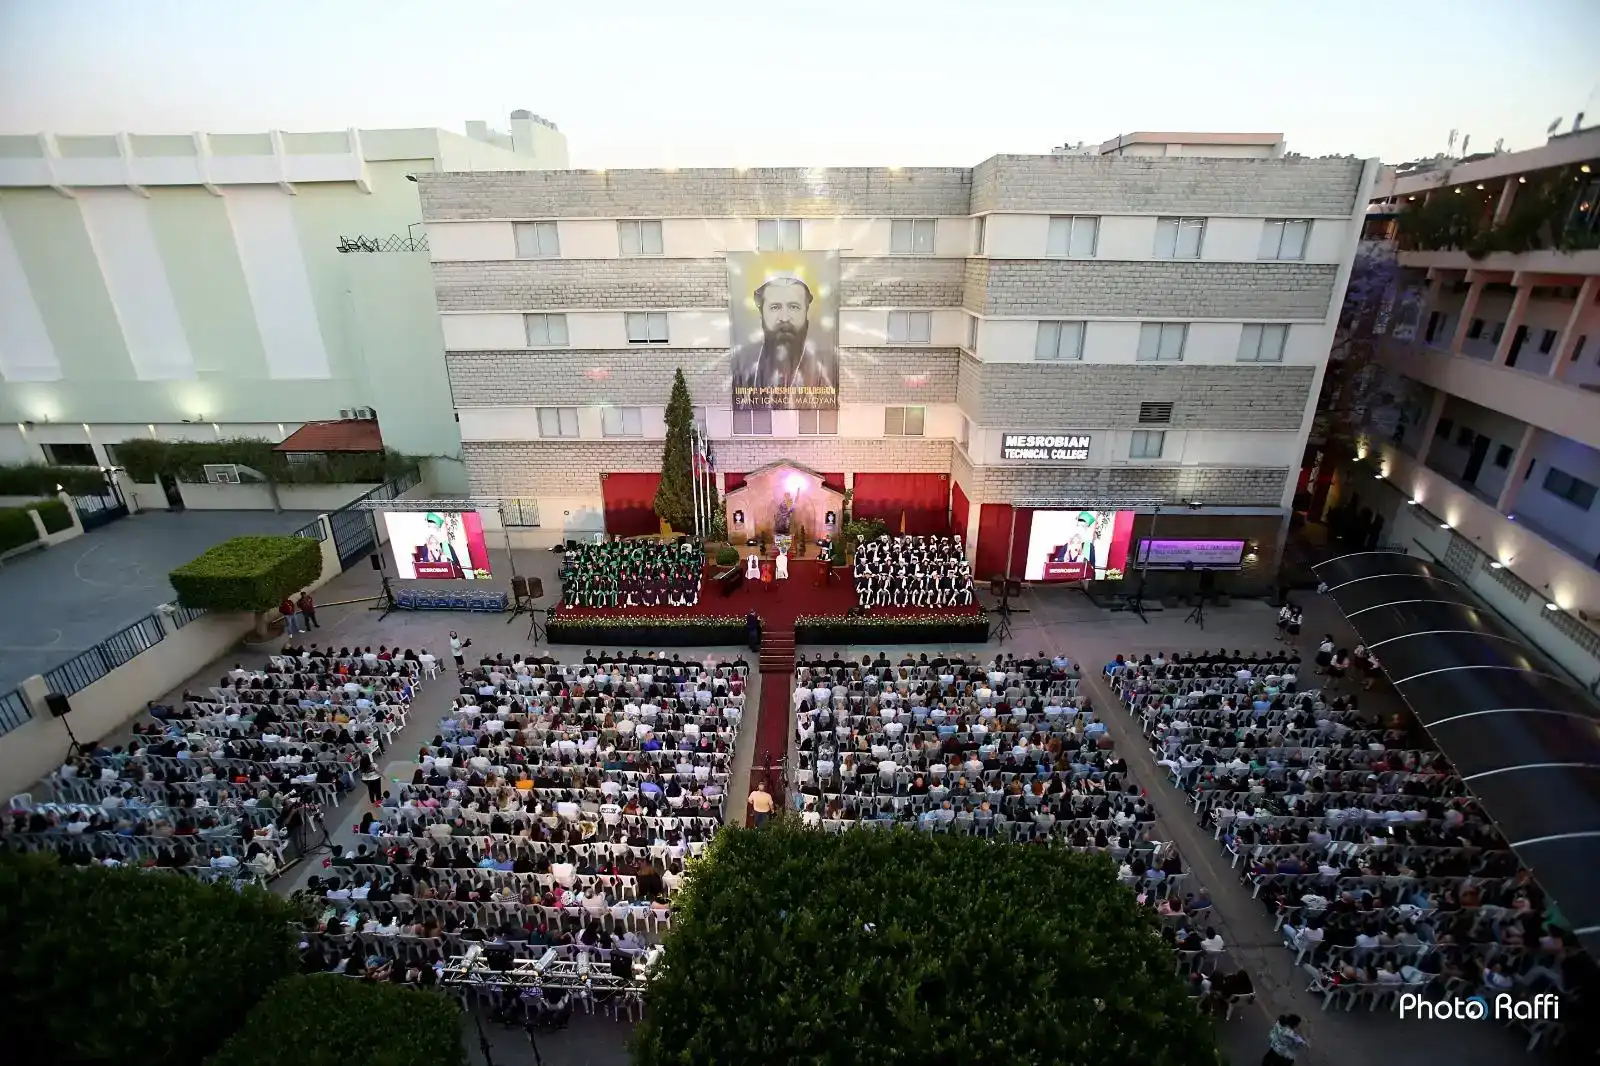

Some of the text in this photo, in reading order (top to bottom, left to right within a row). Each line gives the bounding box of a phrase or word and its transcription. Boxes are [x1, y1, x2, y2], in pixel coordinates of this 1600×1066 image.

[735, 397, 758, 405] SAINT
[761, 397, 791, 405] IGNAC
[1005, 435, 1090, 448] MESROBIAN
[1004, 448, 1088, 459] TECHNICAL COLLEGE
